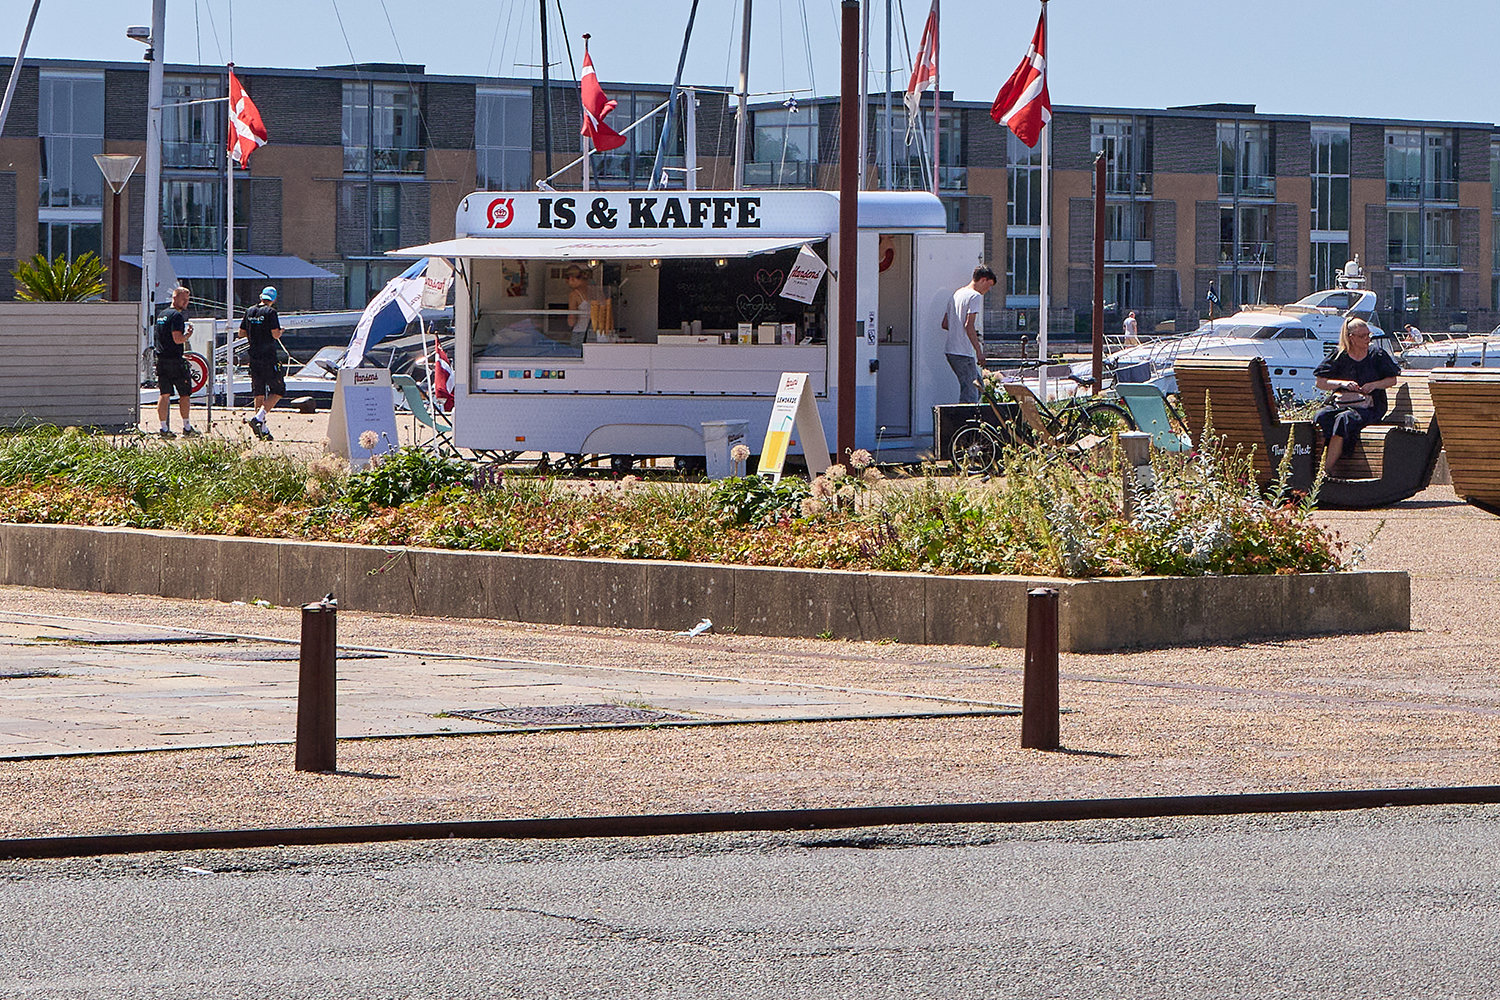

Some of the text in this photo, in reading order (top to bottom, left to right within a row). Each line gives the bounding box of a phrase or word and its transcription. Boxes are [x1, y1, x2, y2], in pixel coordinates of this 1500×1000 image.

[538, 198, 761, 229] IS & KAFFE
